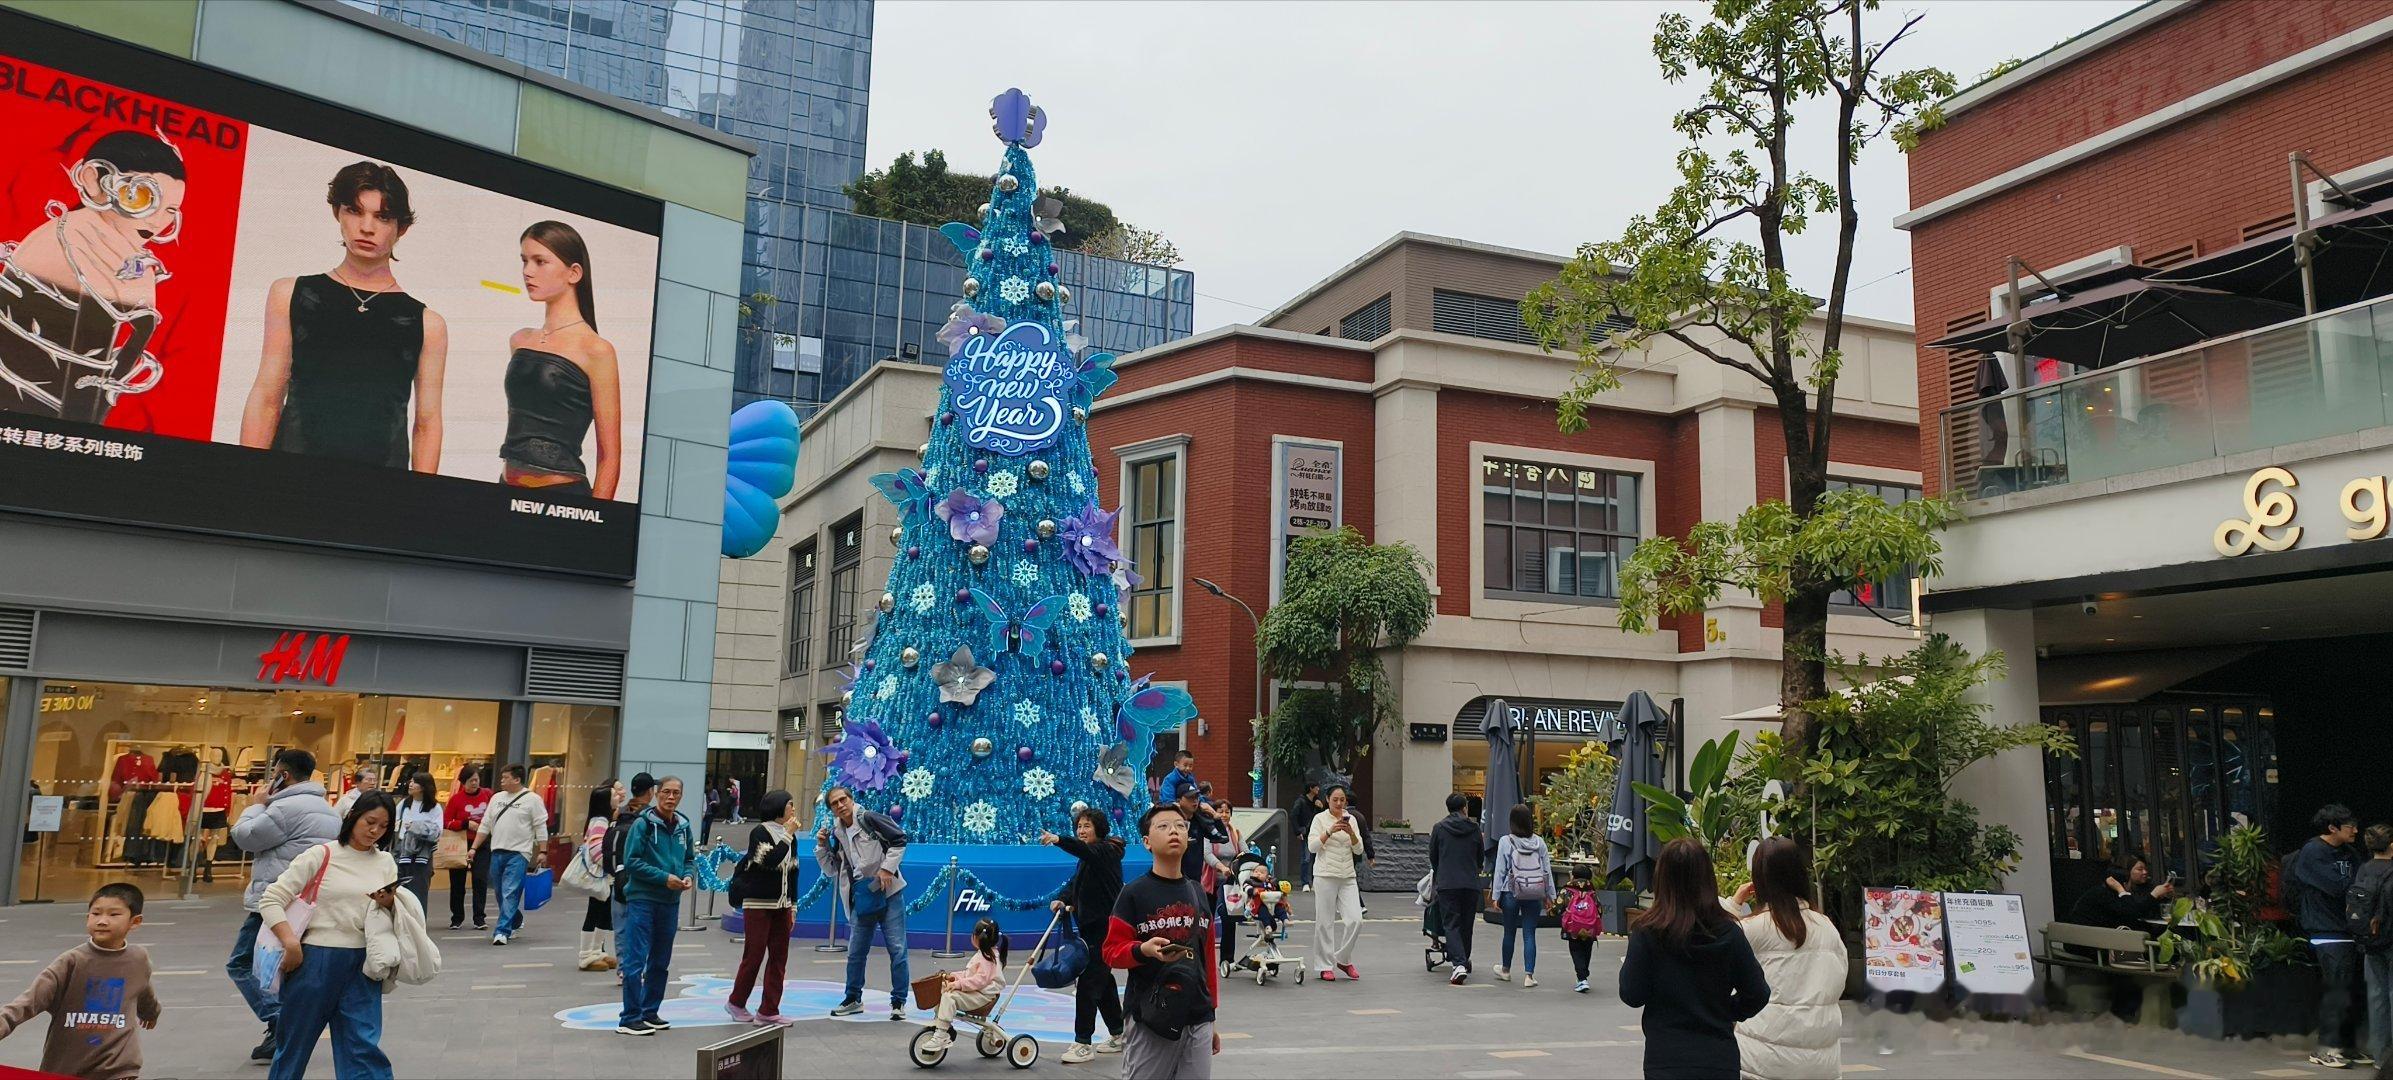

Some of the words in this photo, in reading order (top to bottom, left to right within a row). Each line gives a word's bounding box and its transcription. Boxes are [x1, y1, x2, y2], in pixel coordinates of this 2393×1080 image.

[0, 62, 241, 150] BLACKHEAD
[964, 321, 1056, 380] Happy
[978, 378, 1040, 399] new
[0, 426, 144, 462] 转星移系列银饰
[957, 395, 1063, 442] Year
[510, 499, 545, 515] NEW
[545, 504, 604, 523] ARRIVAL
[2339, 475, 2393, 541] g
[256, 631, 351, 686] H&M
